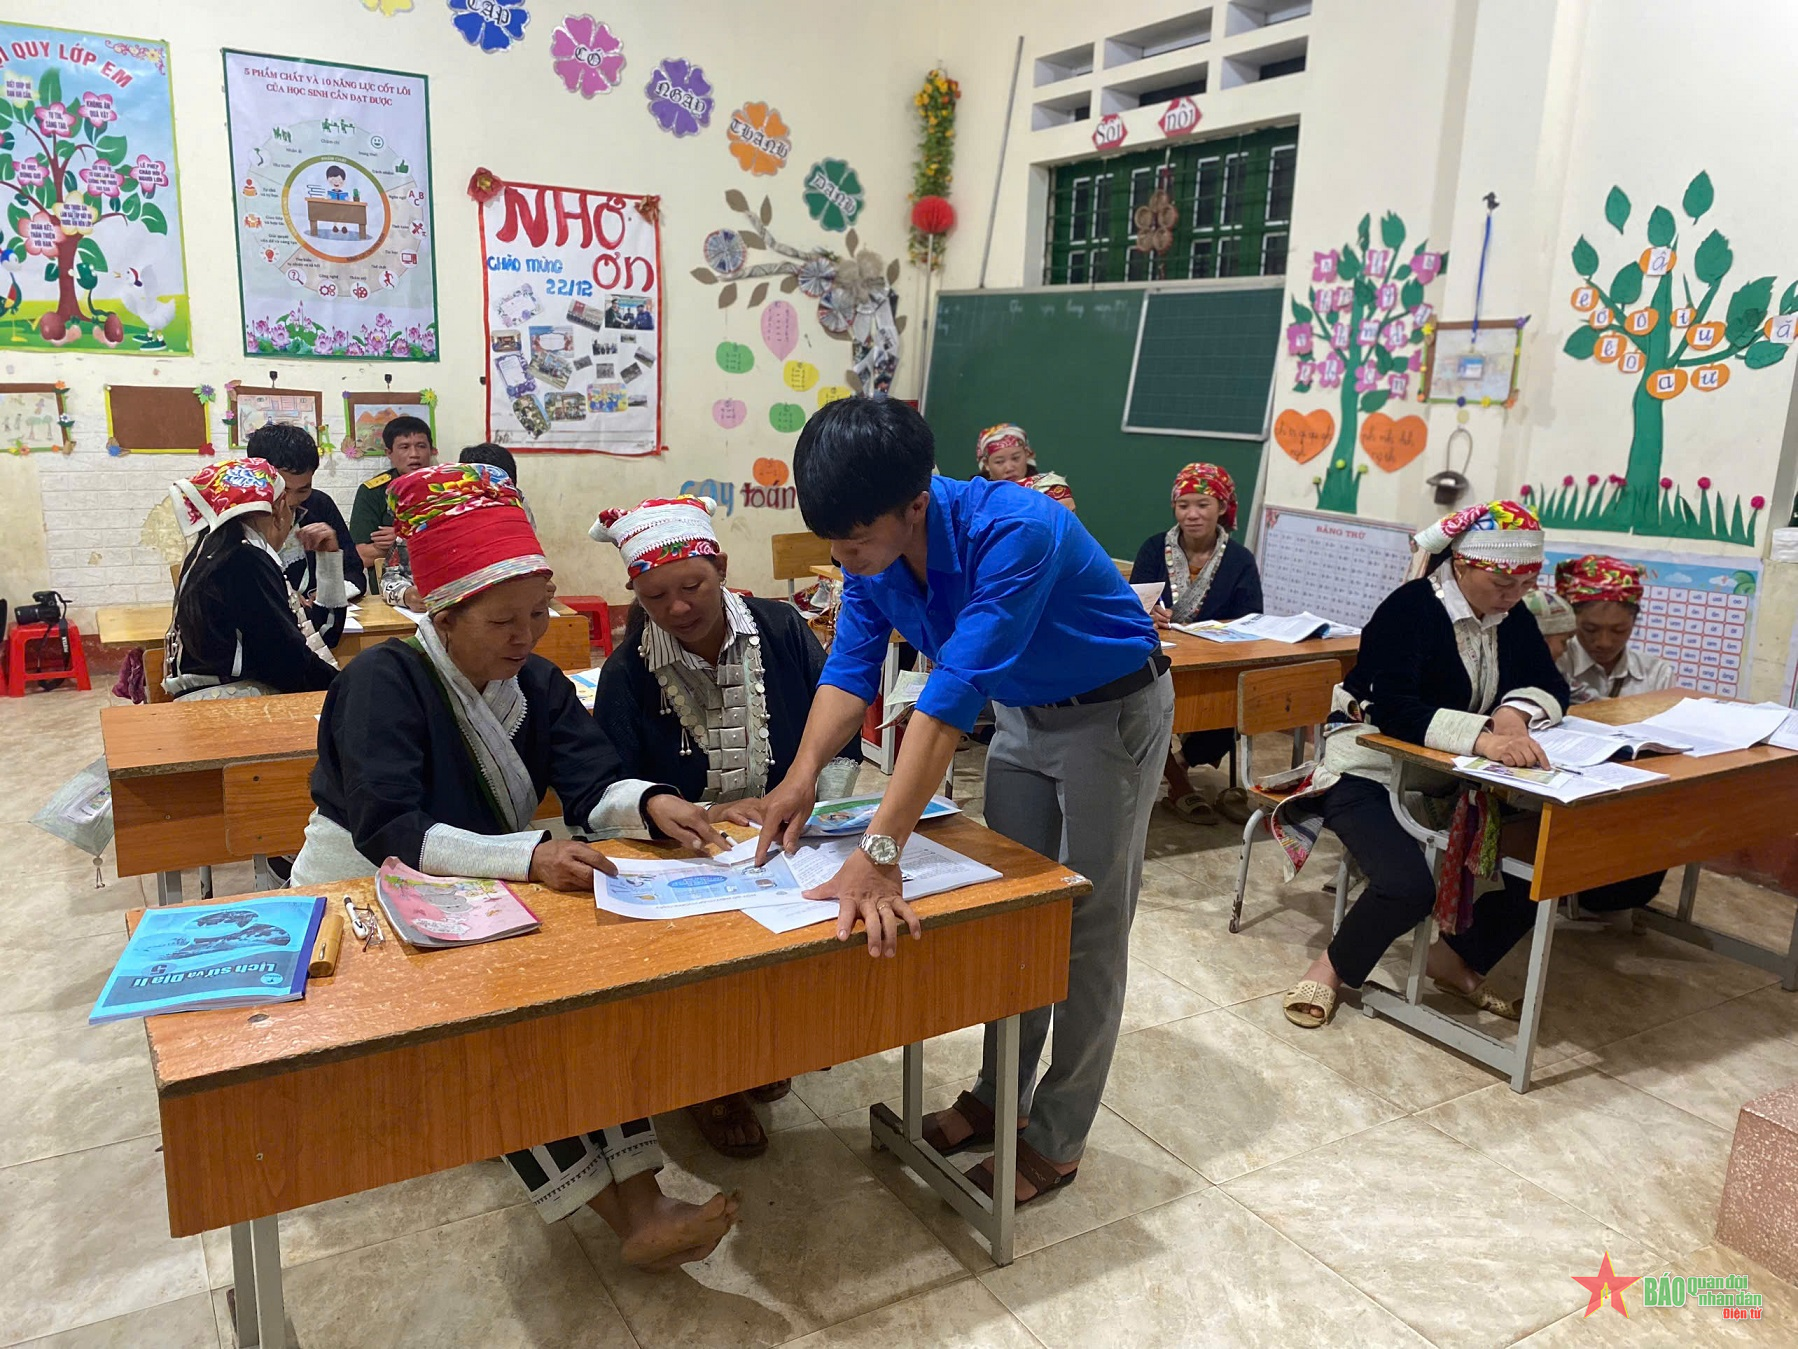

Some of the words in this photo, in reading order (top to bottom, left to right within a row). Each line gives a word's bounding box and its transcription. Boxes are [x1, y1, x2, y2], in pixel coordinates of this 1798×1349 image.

[11, 41, 50, 60] QUY
[59, 43, 97, 66] LỚP
[101, 61, 133, 88] EM
[244, 68, 250, 76] 5
[252, 67, 277, 79] PHẨM
[280, 72, 303, 83] CHẤT
[306, 74, 319, 85] VÀ
[321, 78, 331, 86] 10
[333, 79, 356, 89] NĂNG
[359, 82, 375, 92] LỰC
[266, 82, 284, 92] CỦA
[287, 86, 306, 97] HỌC
[307, 89, 328, 98] SINH
[1651, 251, 1668, 271] â
[546, 278, 593, 297] 22/12
[1580, 293, 1589, 307] e
[1658, 376, 1675, 390] a
[740, 480, 796, 510] toán
[1316, 525, 1343, 536] BẢNG
[150, 964, 168, 976] 5
